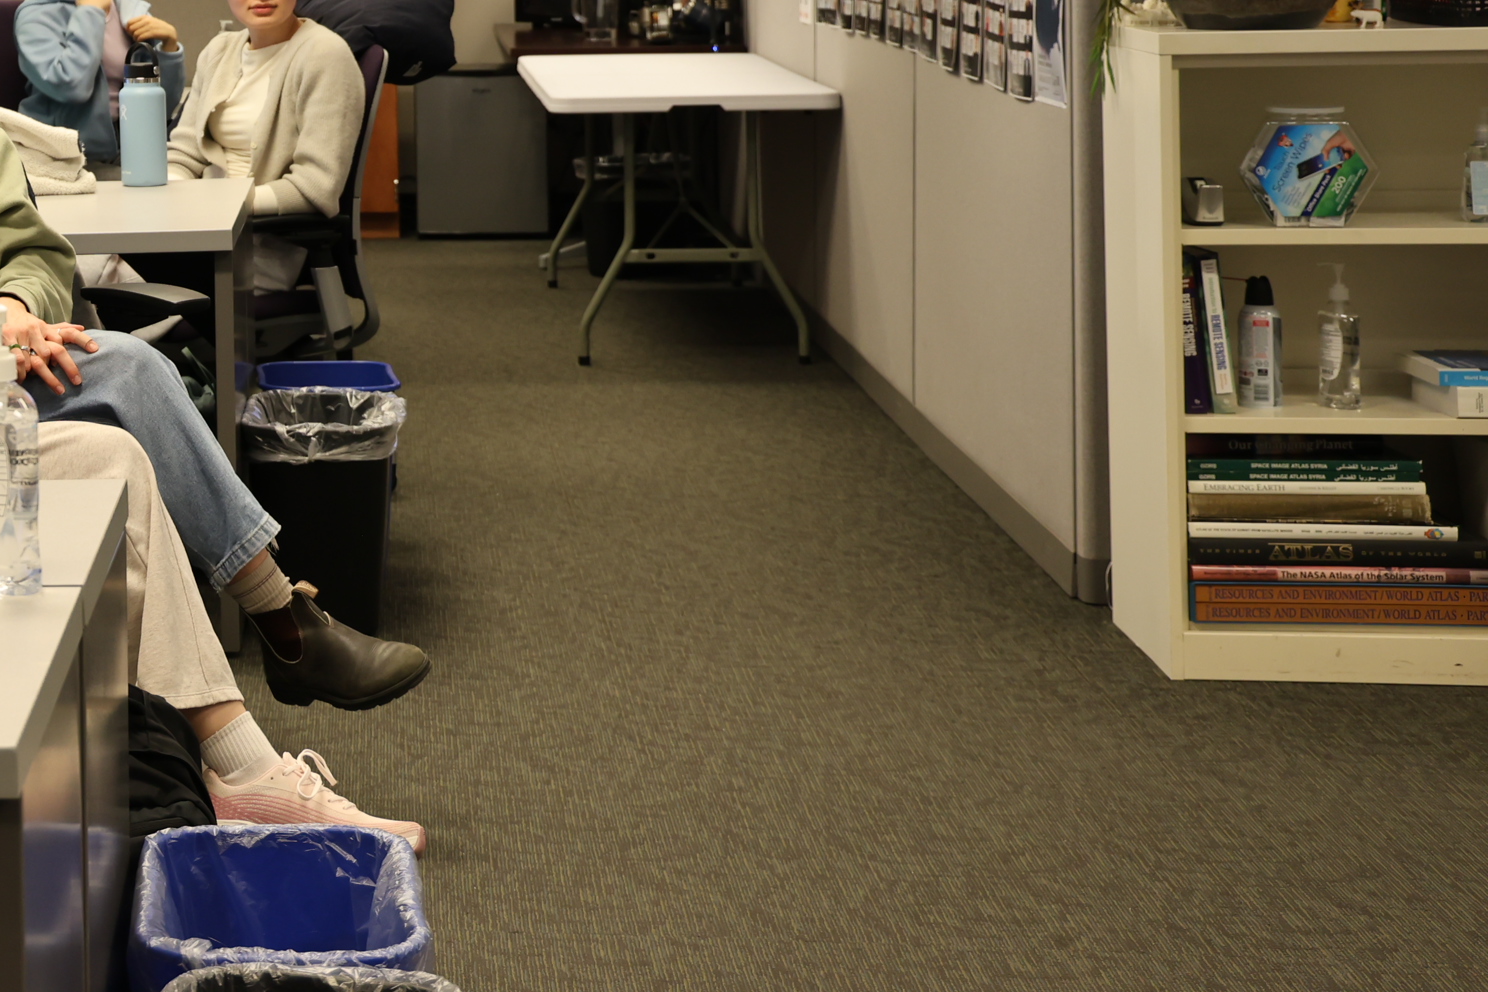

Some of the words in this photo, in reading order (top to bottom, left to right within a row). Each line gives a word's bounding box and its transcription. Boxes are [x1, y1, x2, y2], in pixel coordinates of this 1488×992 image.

[1272, 161, 1296, 193] Screen
[1290, 132, 1314, 160] Wipes
[1332, 175, 1347, 195] 200
[1211, 313, 1223, 341] REMOTE
[1184, 323, 1198, 357] SENSING
[1214, 341, 1228, 371] SENSING
[1315, 438, 1354, 450] Planet
[1268, 544, 1354, 561] ATLAS
[1280, 570, 1298, 579] The
[1299, 570, 1327, 579] NASA
[1328, 570, 1353, 580] Atlas
[1354, 571, 1365, 580] of
[1366, 571, 1382, 581] the
[1383, 572, 1408, 581] Solar
[1411, 572, 1445, 583] System
[1214, 588, 1274, 600] RESOURCES
[1277, 589, 1300, 600] AND
[1426, 590, 1460, 602] ATLAS
[1212, 607, 1271, 619] RESOURCES
[1273, 608, 1297, 619] AND
[1424, 609, 1458, 621] ATLAS
